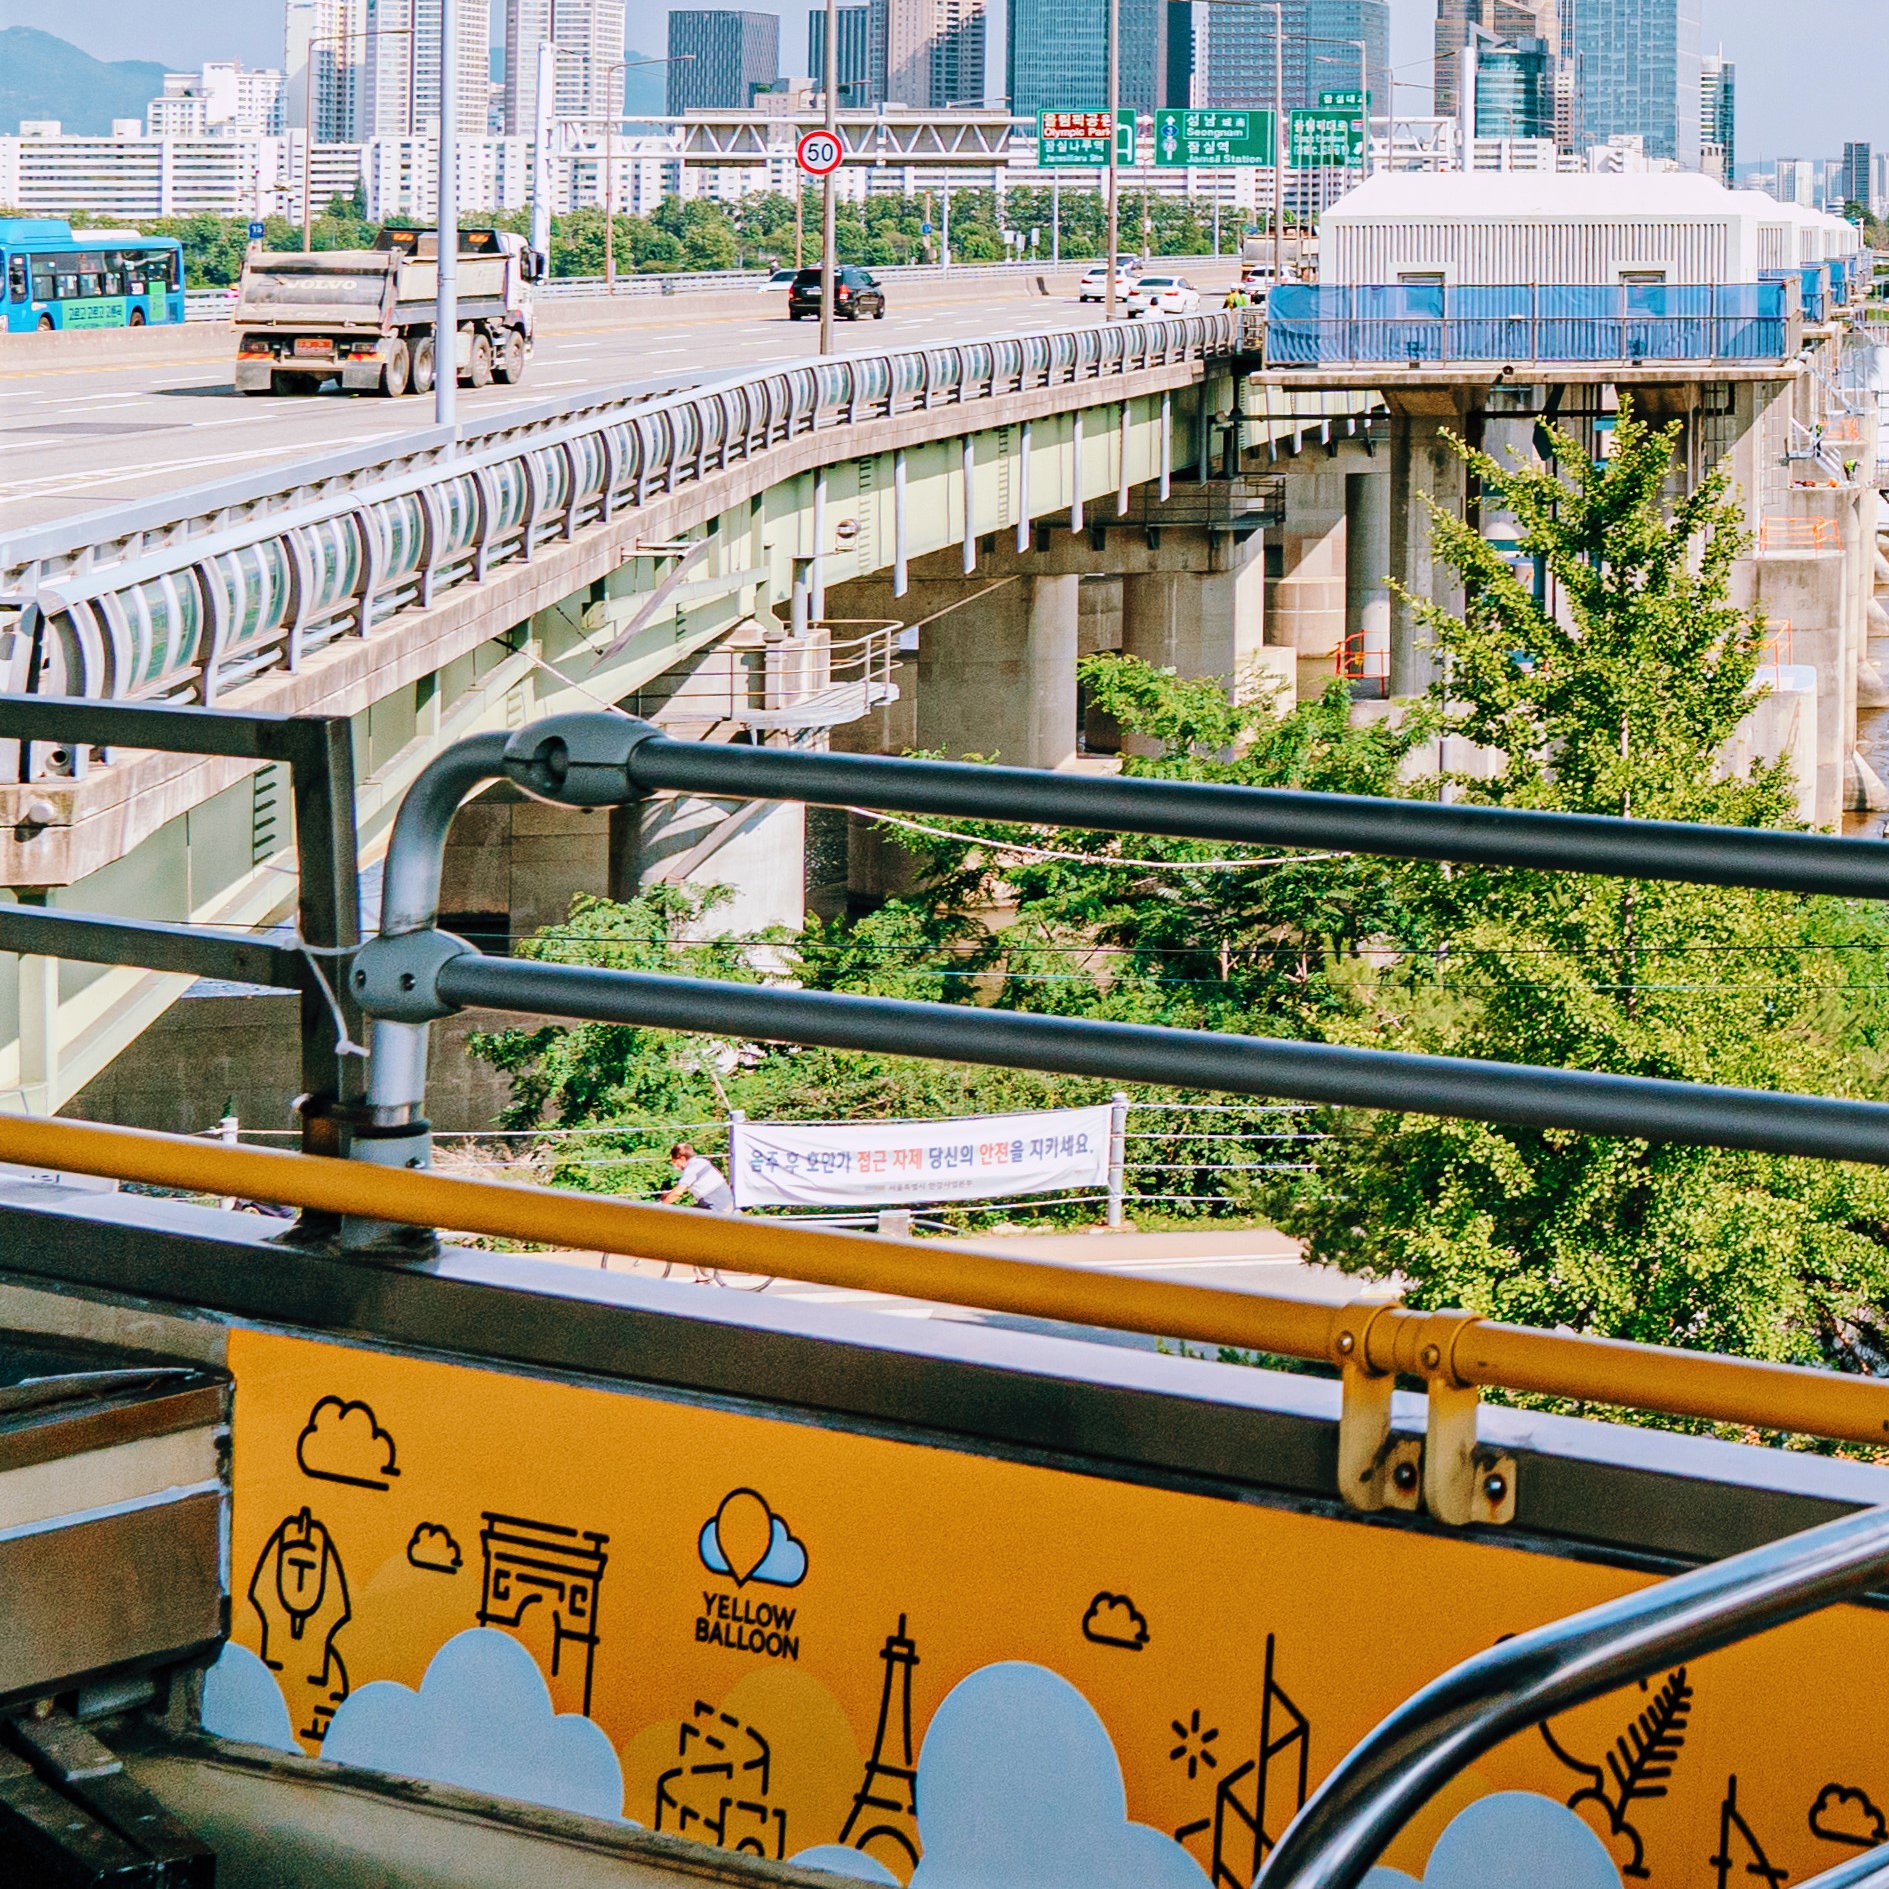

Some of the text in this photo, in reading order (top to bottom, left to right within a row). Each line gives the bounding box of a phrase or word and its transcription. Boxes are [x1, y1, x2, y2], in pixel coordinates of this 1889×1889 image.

[1187, 113, 1216, 127] 성남
[1044, 127, 1085, 138] Olympic
[1167, 127, 1174, 136] 3
[1187, 127, 1244, 139] Seongnam
[807, 143, 833, 162] 50
[1045, 140, 1104, 153] 잠실나루역
[1187, 141, 1230, 154] 잠실역
[1187, 154, 1263, 163] Jamsil Station
[286, 280, 358, 290] VOLVO
[750, 1149, 779, 1173] 음주
[857, 1150, 887, 1173] 접근
[893, 1148, 923, 1171] 자제
[929, 1144, 974, 1170] 당신의
[979, 1139, 1024, 1166] 안전을
[1029, 1133, 1094, 1161] 지키세요.
[703, 1591, 797, 1631] YELLOW
[695, 1617, 799, 1662] BALLOON
